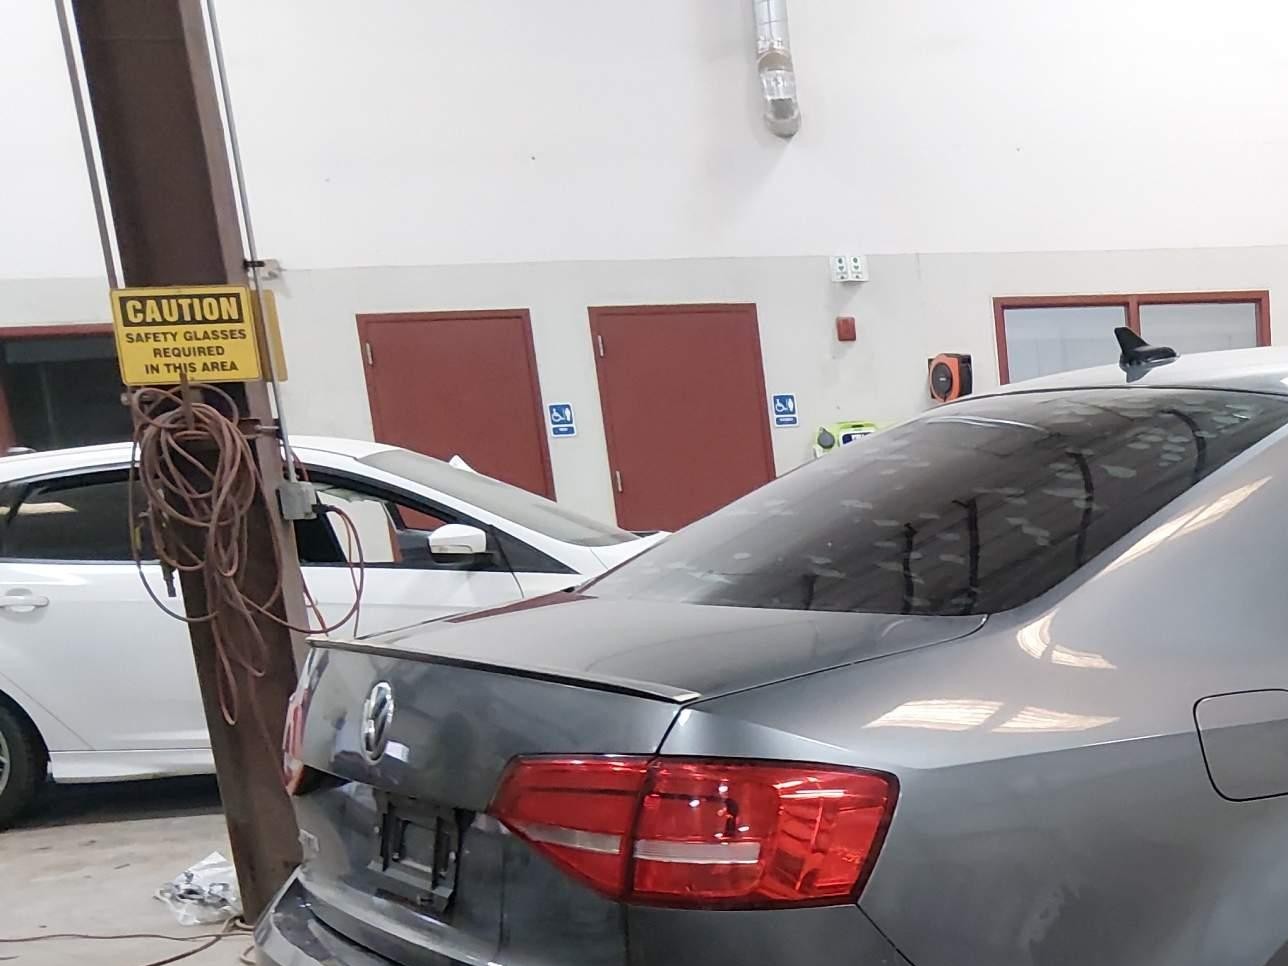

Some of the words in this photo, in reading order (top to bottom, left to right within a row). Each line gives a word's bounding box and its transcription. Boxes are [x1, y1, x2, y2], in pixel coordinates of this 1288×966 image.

[125, 296, 239, 324] CAUTION
[125, 331, 178, 344] SAFETY
[183, 329, 247, 342] GLASSES
[153, 345, 225, 358] REQUIRED
[144, 363, 160, 375] IN
[163, 362, 197, 374] THIS
[201, 360, 239, 373] AREA
